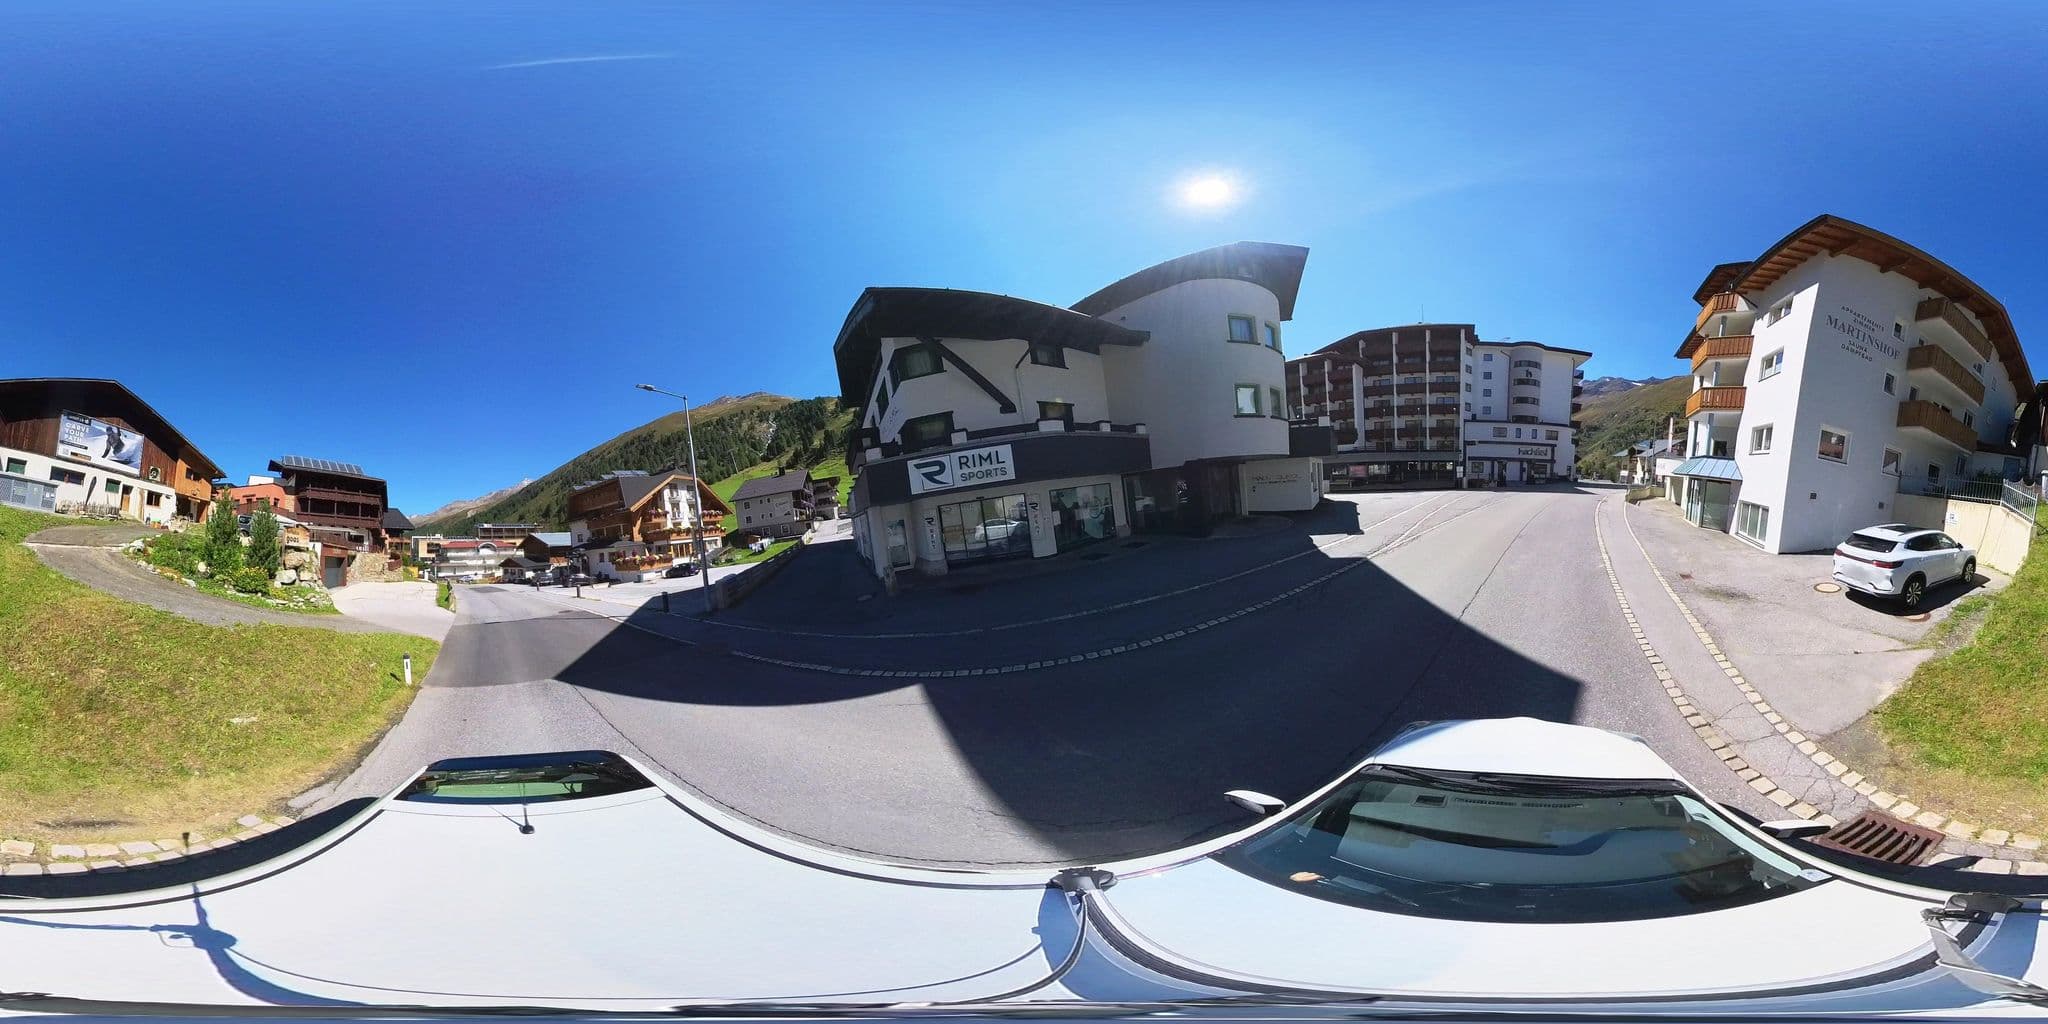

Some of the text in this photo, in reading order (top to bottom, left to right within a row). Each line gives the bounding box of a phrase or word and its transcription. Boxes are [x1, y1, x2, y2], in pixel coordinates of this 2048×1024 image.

[1826, 314, 1900, 359] MARTINSHOF
[958, 450, 1006, 470] RIML
[960, 467, 1008, 482] SPORTS
